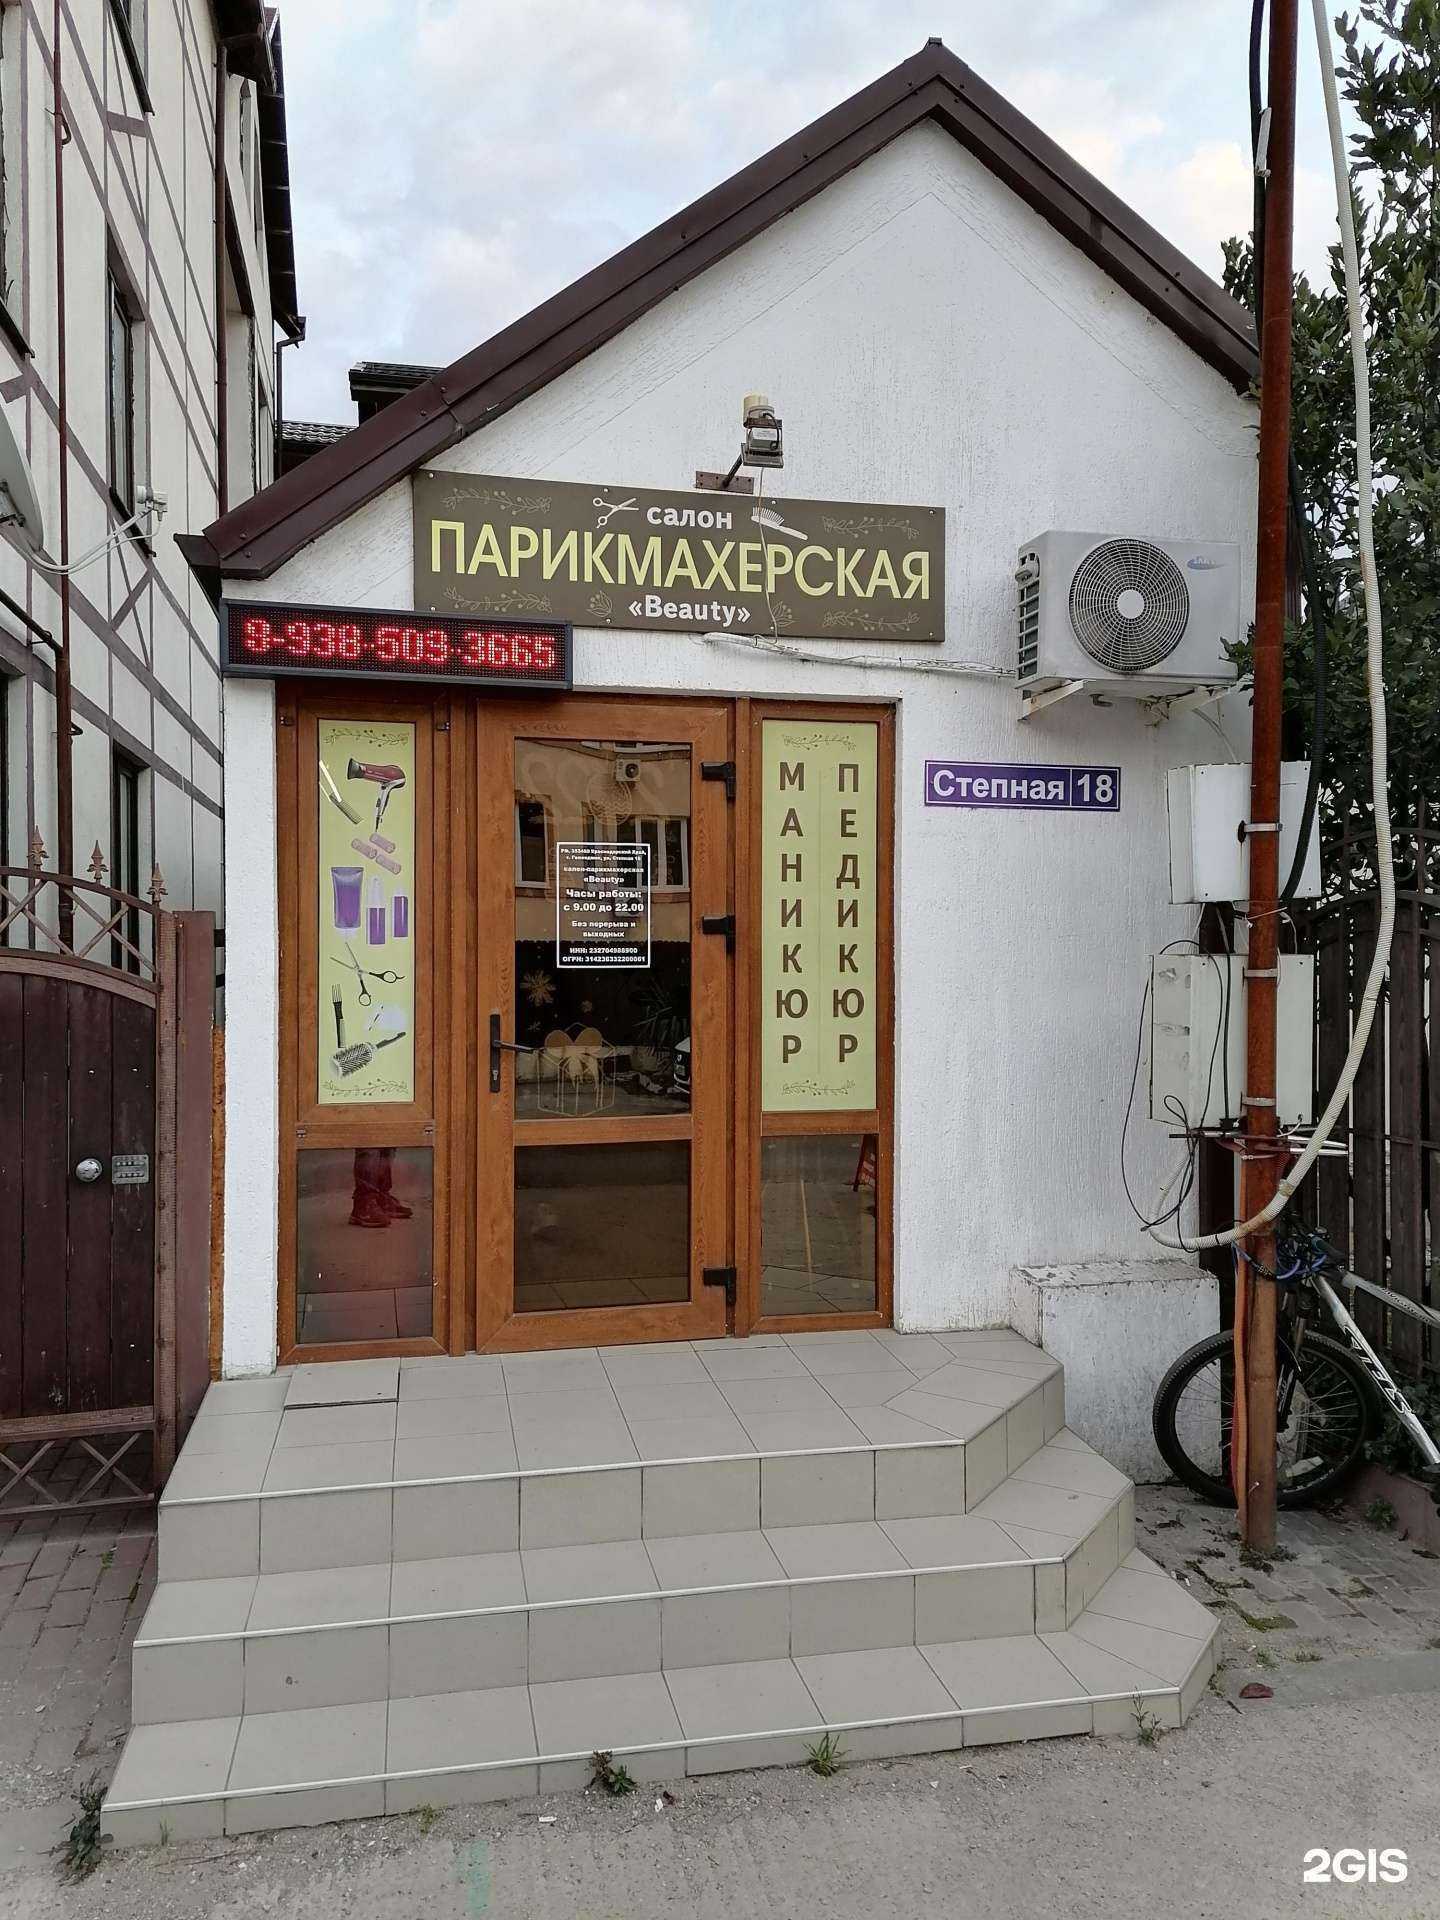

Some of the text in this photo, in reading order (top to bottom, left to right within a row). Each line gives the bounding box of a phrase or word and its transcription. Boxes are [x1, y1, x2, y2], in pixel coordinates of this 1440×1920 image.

[646, 505, 733, 530] салон
[430, 519, 930, 600] ПАРИКМАХЕРСКАЯ
[628, 595, 752, 628] «Beauty»
[932, 768, 1114, 803] Степная 18
[566, 888, 642, 900] Часы работы:
[583, 875, 625, 885] «Beauty»
[563, 902, 644, 913] с 9.00 до 22.00
[775, 760, 809, 1065] МАНИКЮР
[832, 762, 865, 1064] ПЕДИКЮР
[571, 920, 588, 928] Без
[589, 921, 629, 929] перерыва
